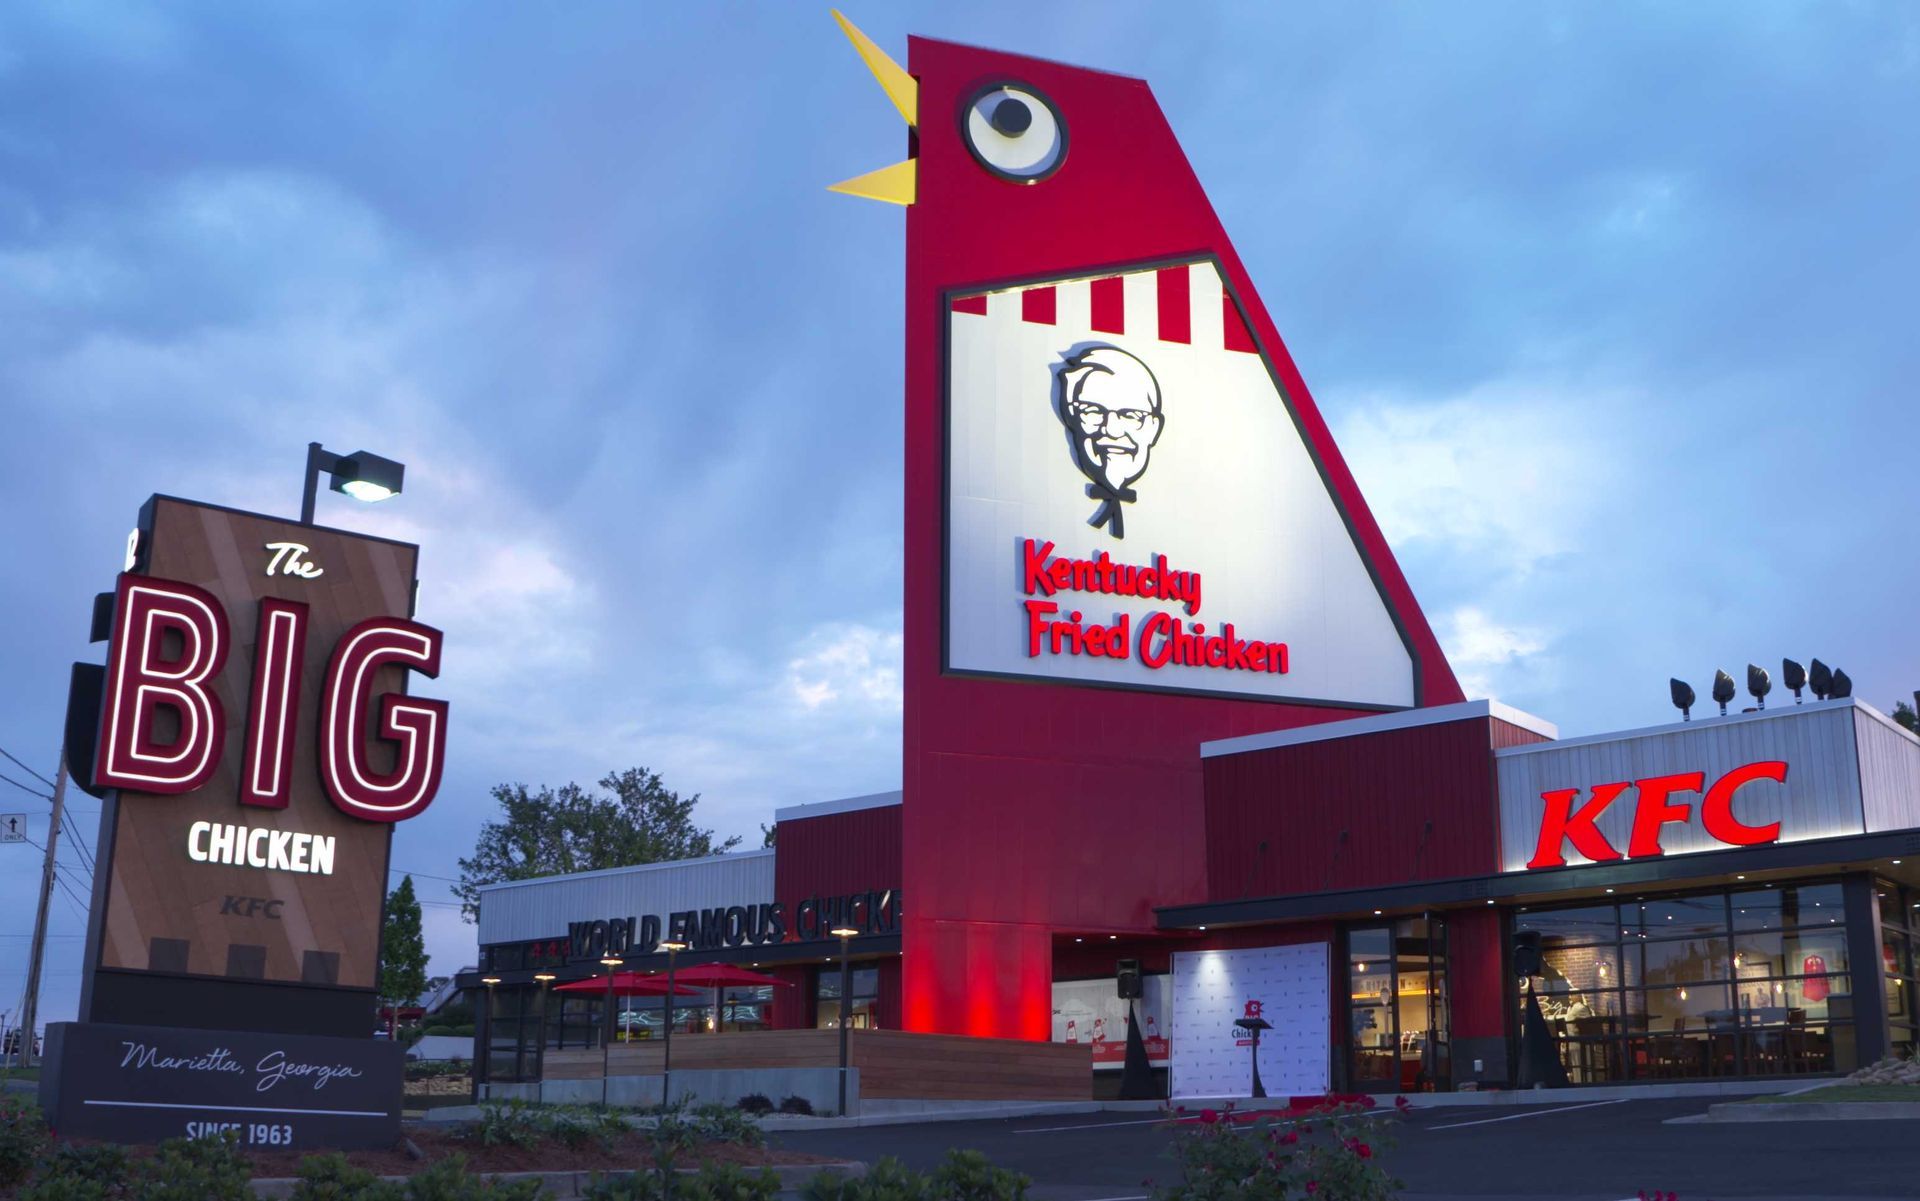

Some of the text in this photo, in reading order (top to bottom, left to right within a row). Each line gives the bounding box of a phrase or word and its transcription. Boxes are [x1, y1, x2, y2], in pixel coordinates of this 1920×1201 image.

[265, 542, 324, 579] The
[1024, 538, 1201, 616] Kentucky
[1025, 600, 1290, 675] Fried Chicken
[91, 571, 450, 823] BIG
[1526, 760, 1789, 870] KFC
[188, 821, 336, 875] CHICKEN
[219, 895, 285, 920] KFC
[568, 889, 902, 957] WORLD FAMOUS CHICKE
[121, 1041, 363, 1092] Marietta, Georgia
[248, 1123, 293, 1145] 1963
